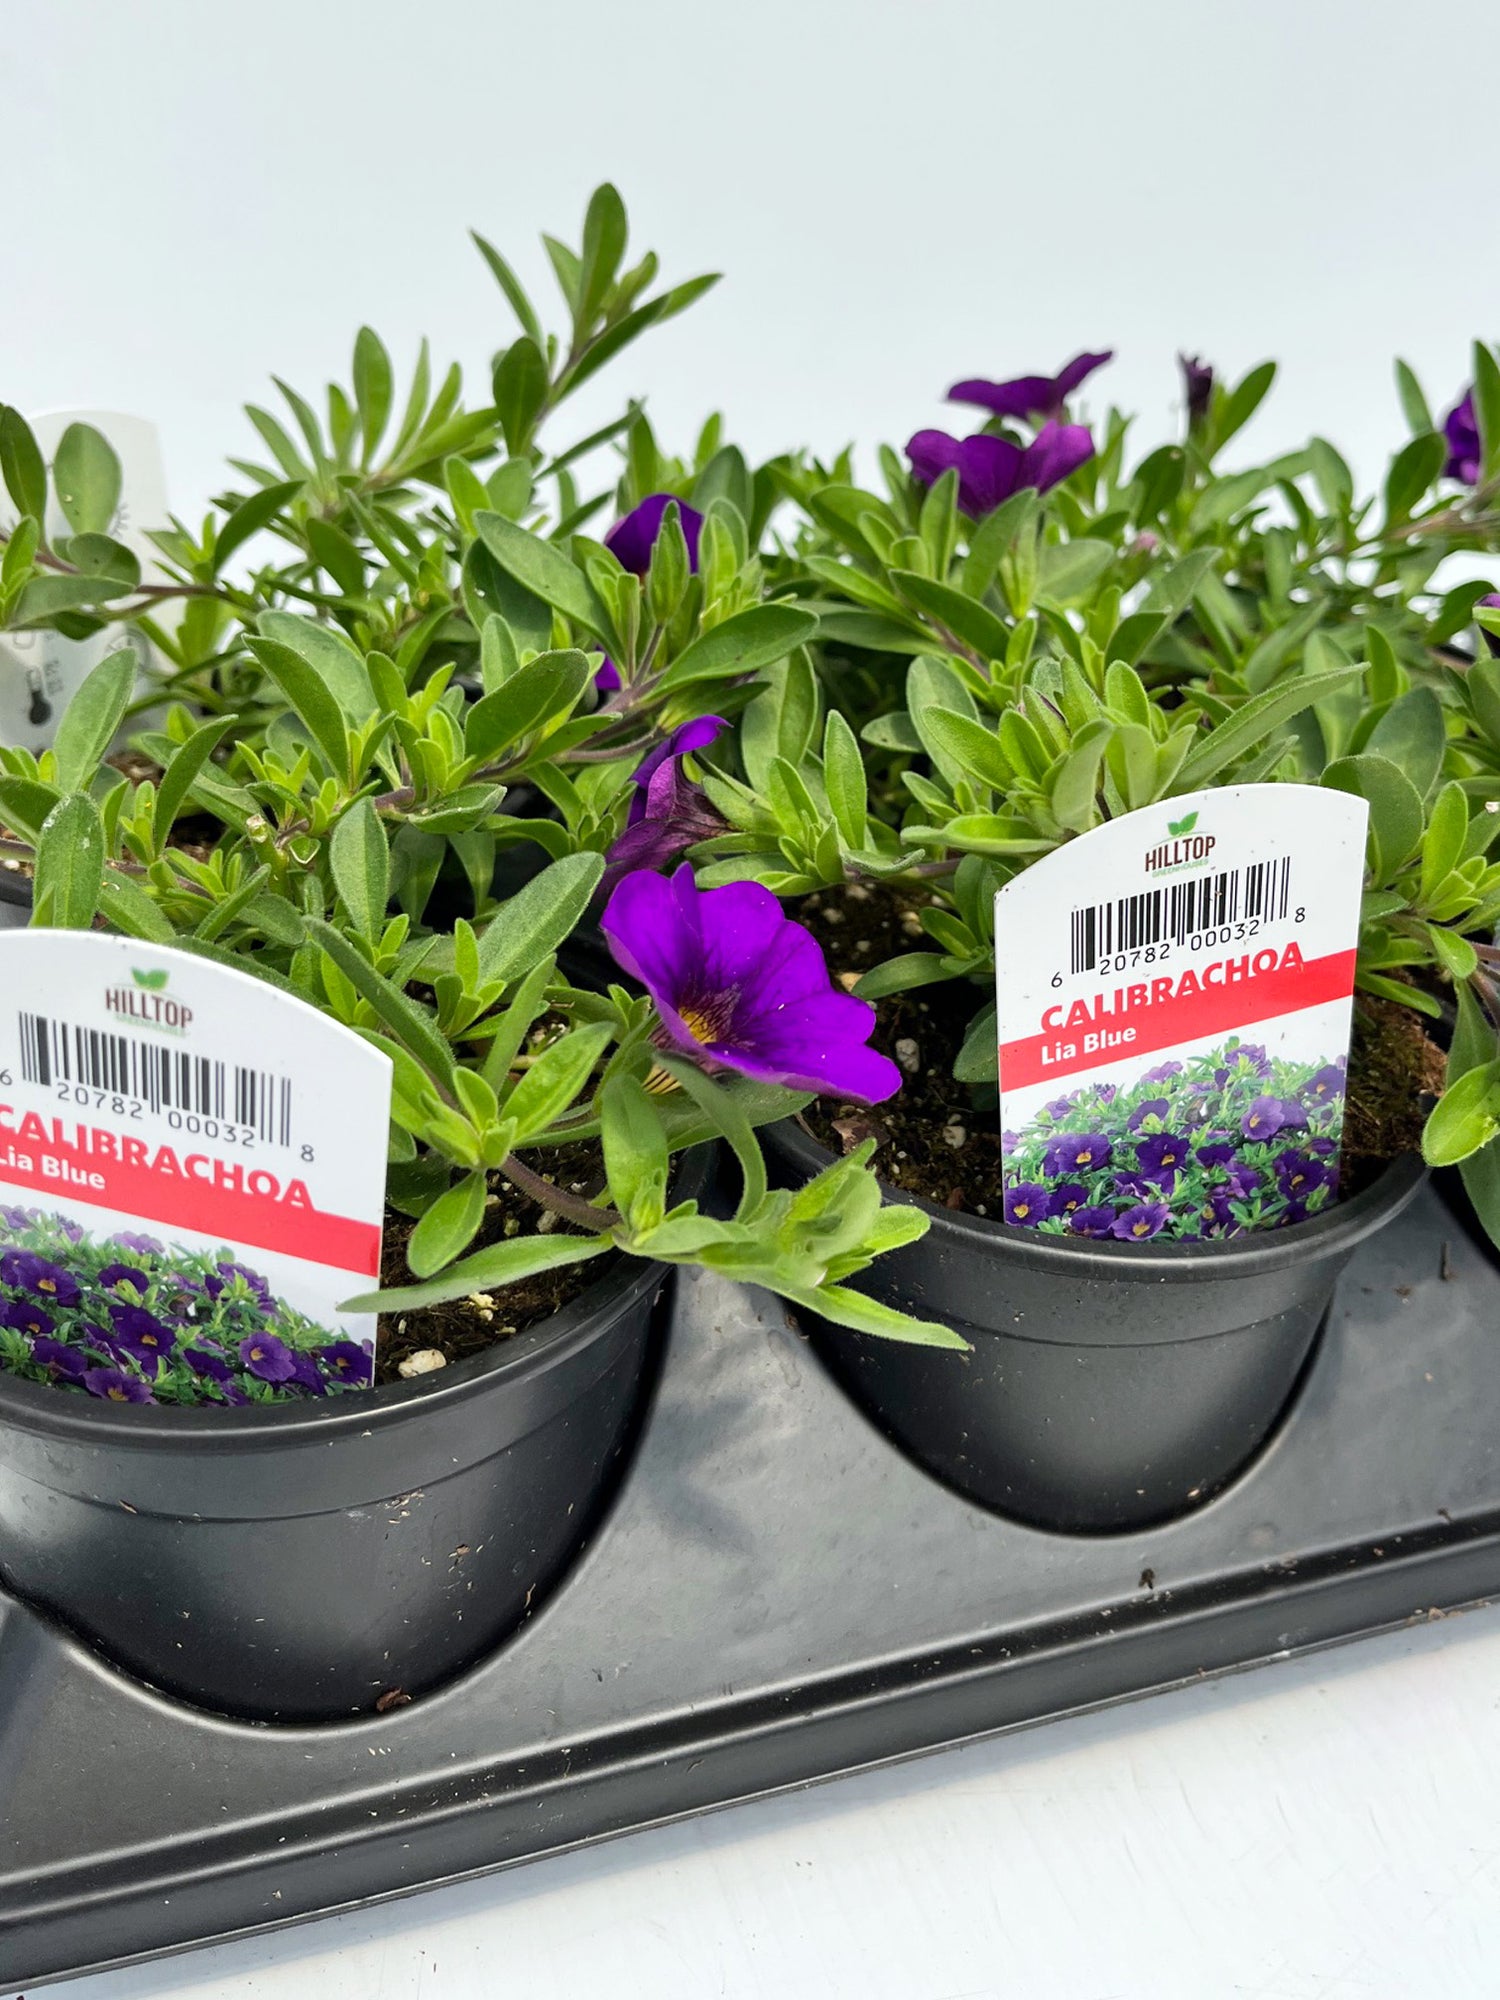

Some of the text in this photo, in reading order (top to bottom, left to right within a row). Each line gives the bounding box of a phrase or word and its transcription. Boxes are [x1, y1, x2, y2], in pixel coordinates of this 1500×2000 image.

[1144, 835, 1216, 872] HILLTOP
[1050, 906, 1307, 988] 6 20782 00032 8
[1040, 941, 1304, 1034] CALIBRACHOA
[105, 988, 193, 1029] HILLTOP
[1041, 1026, 1137, 1065] Lia Blue
[0, 1068, 316, 1163] 6 20782 00032 8
[41, 1153, 106, 1190] Blue
